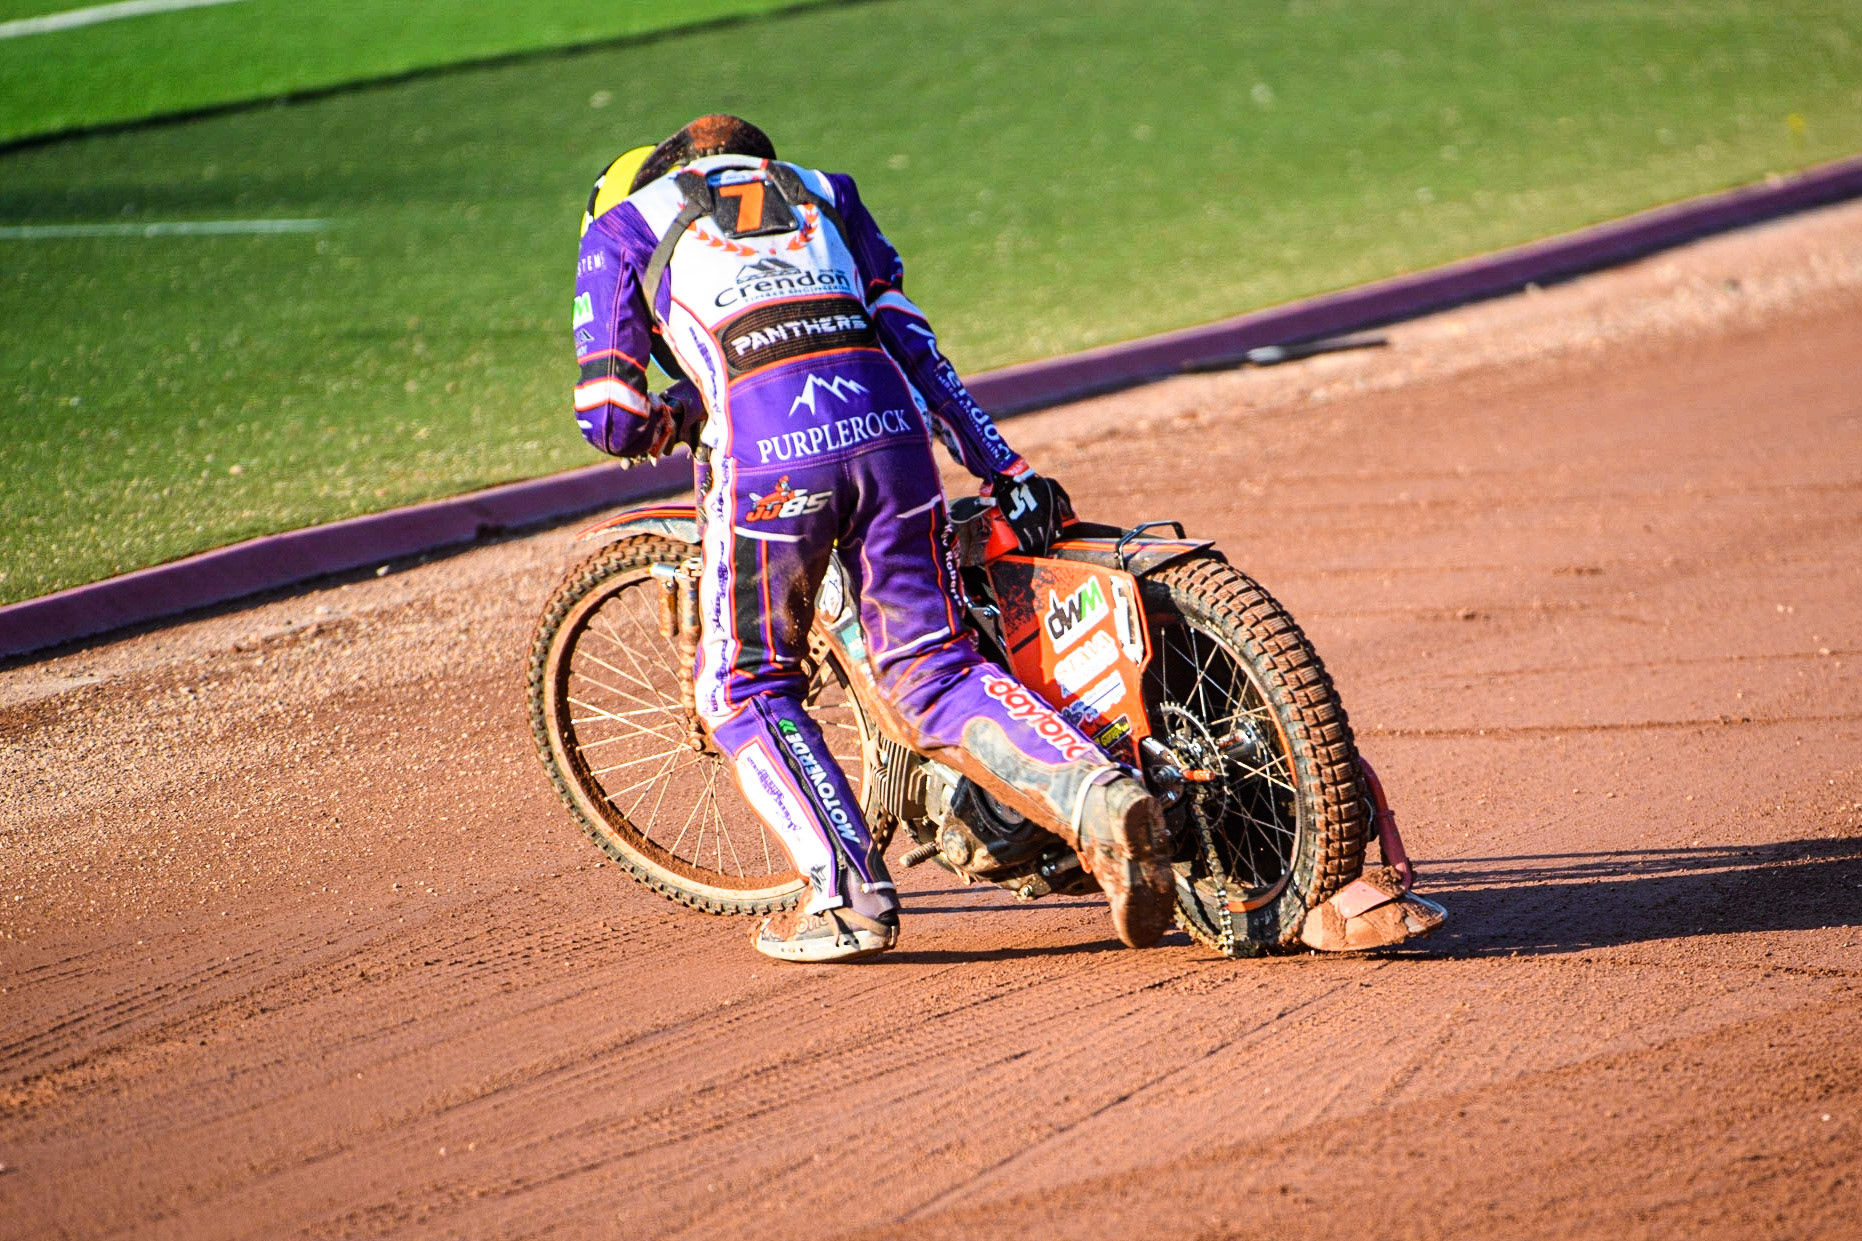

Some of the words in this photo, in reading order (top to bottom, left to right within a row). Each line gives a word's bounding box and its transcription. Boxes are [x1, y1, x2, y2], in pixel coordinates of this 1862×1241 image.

[718, 181, 765, 233] 7
[715, 269, 851, 308] Crendon
[731, 314, 868, 356] PANTHERS
[756, 408, 912, 464] PURPLEROCK
[745, 490, 834, 523] JJ85
[785, 731, 861, 845] MOTOVERDE
